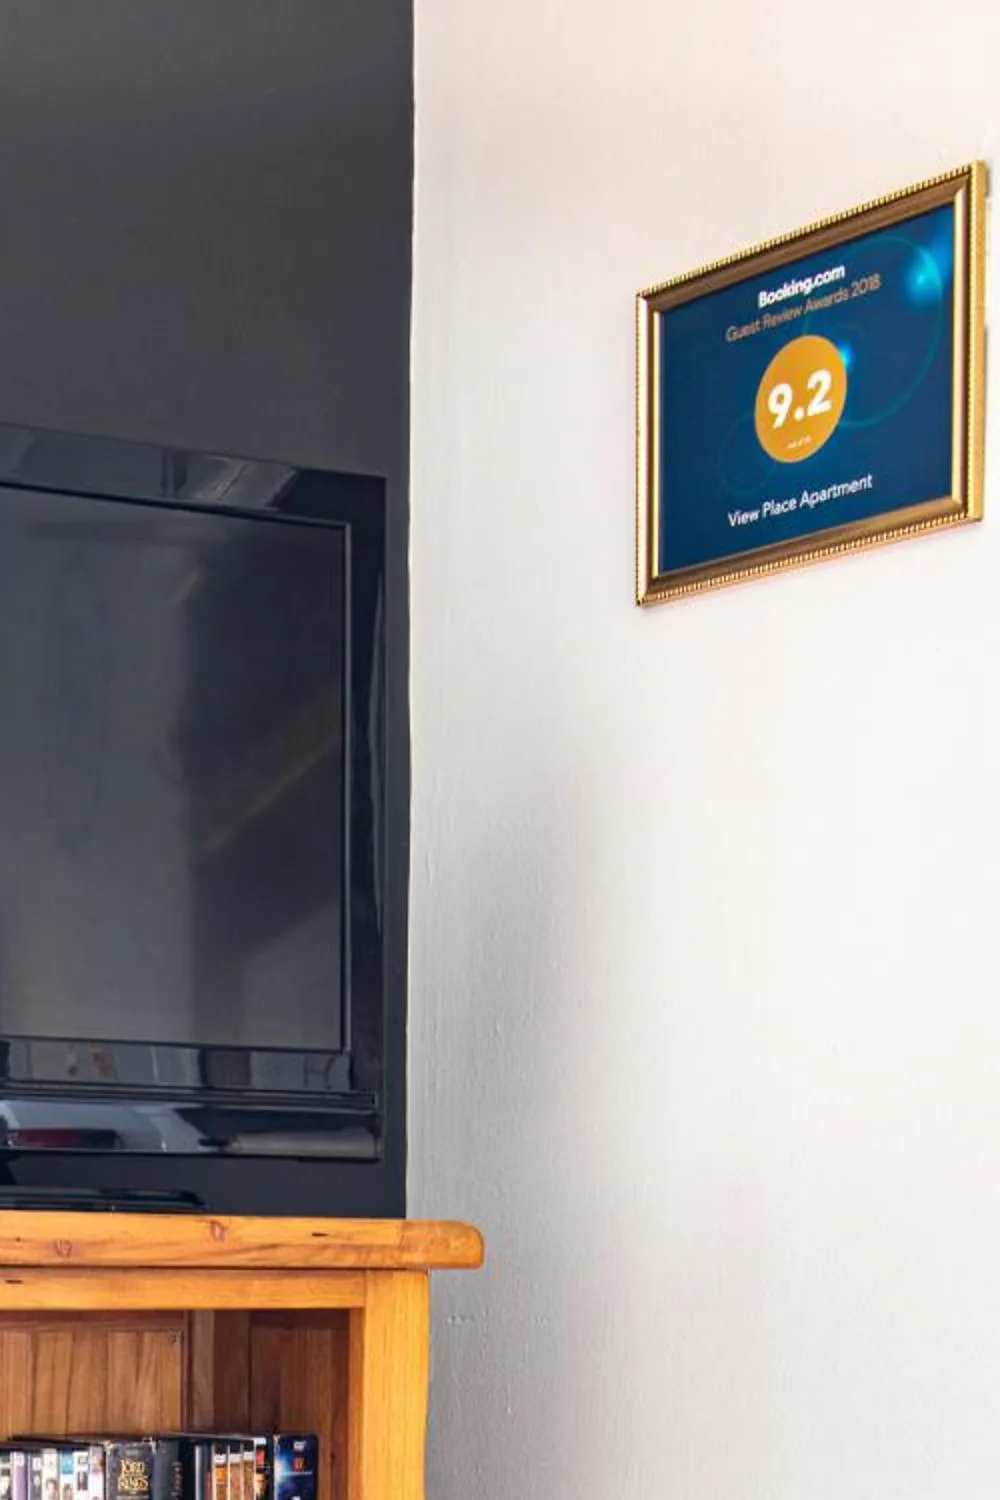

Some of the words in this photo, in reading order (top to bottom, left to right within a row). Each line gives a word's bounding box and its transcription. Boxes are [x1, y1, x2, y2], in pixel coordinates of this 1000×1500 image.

[726, 318, 761, 343] Guest
[762, 304, 802, 329] Review
[803, 286, 849, 314] Awards
[850, 272, 881, 299] 2018
[758, 265, 846, 309] Booking.com
[768, 368, 833, 430] 9.2
[727, 507, 760, 528] View
[762, 495, 798, 520] Place
[799, 473, 874, 509] Apartment
